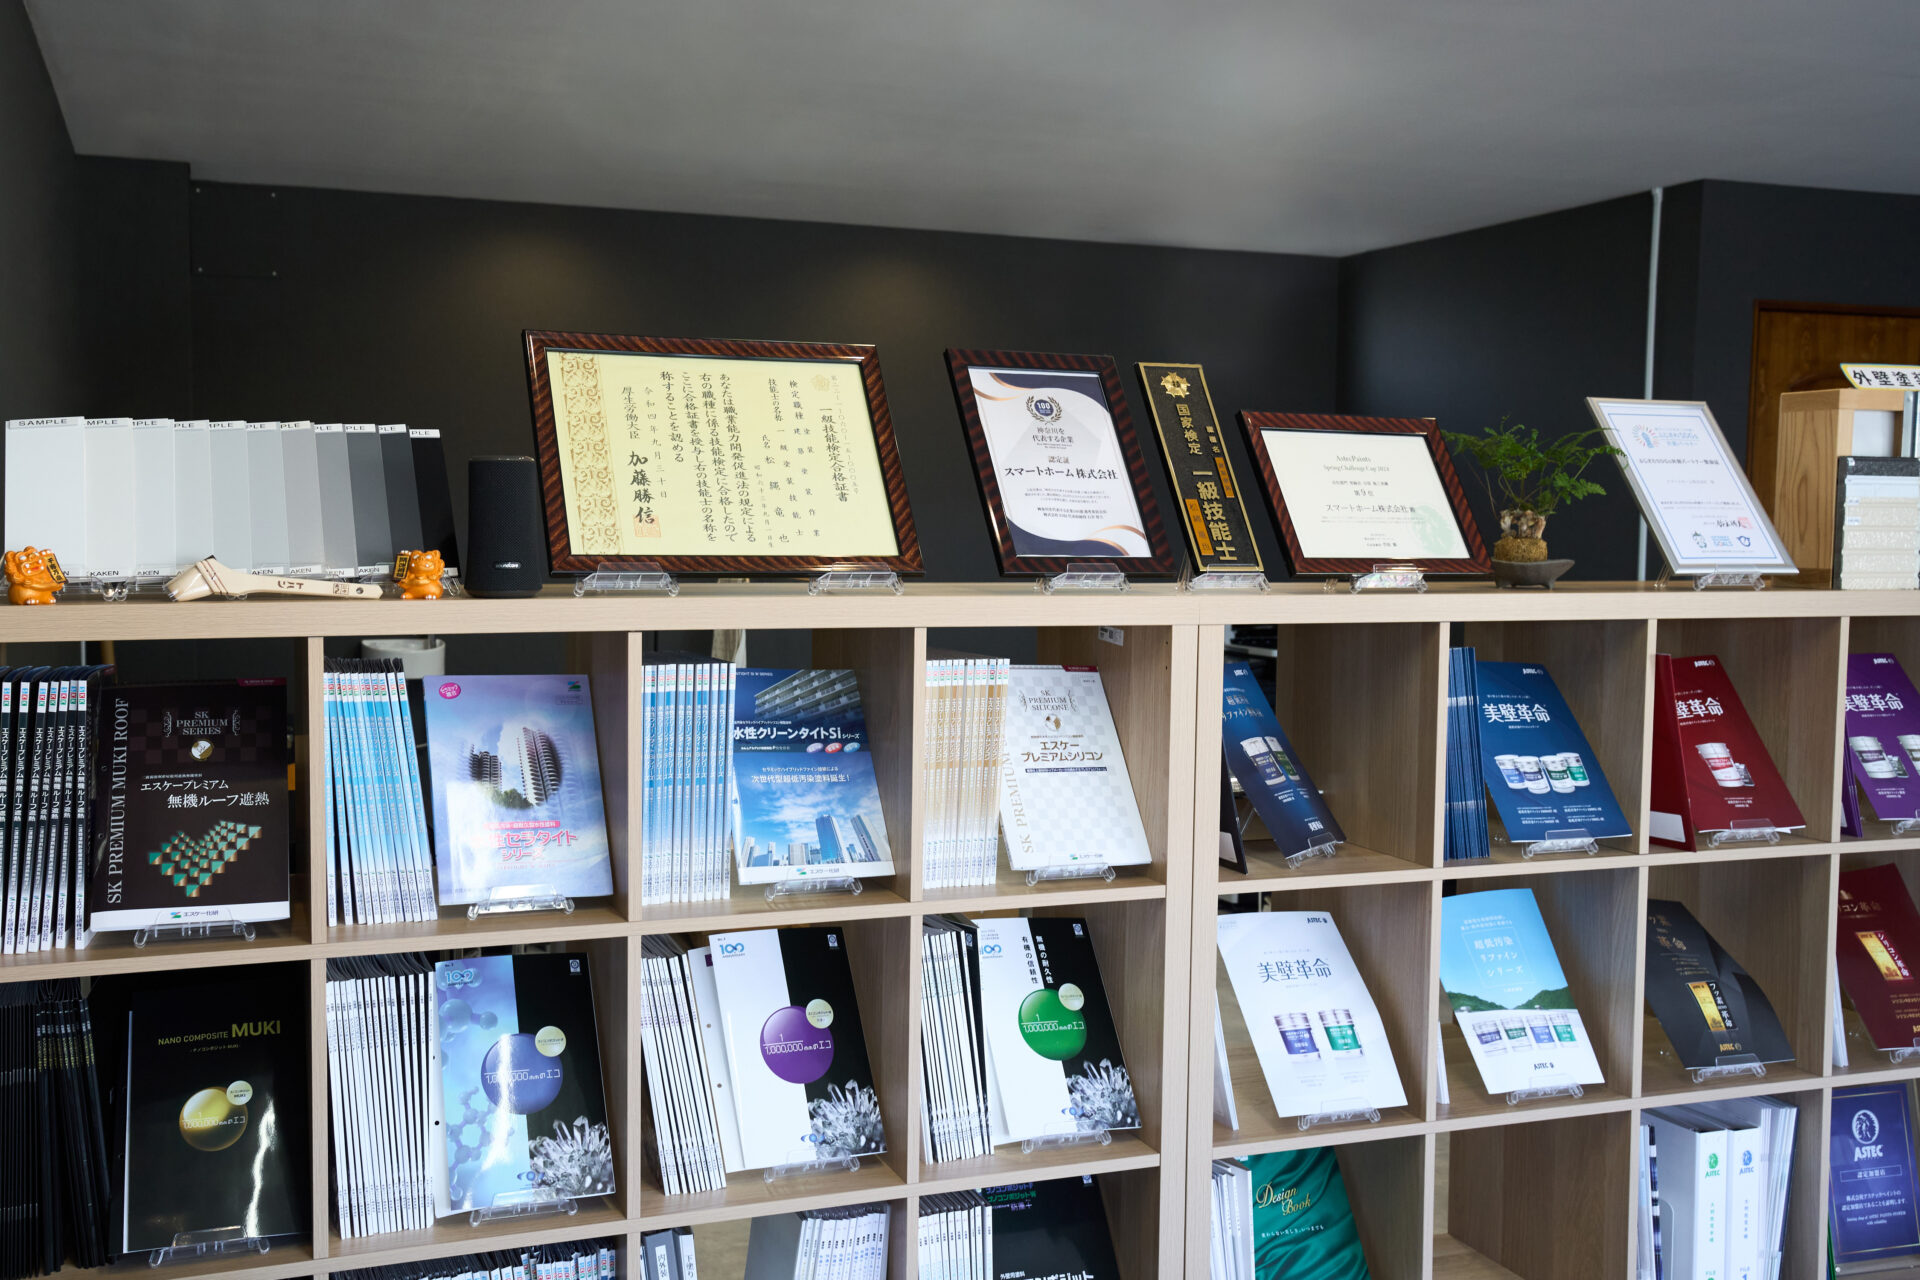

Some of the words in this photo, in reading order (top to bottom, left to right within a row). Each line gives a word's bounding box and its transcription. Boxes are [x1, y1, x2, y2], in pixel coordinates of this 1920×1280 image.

[18, 418, 68, 427] SAMPLE
[621, 386, 641, 440] 厚生労働大臣
[660, 370, 685, 464] 称することを認める
[280, 422, 301, 430] PLE
[1175, 403, 1204, 456] 国家検定
[681, 371, 718, 543] ここに合格証書を授与し右の技能士の名称を
[699, 372, 737, 543] 右の職種に係る技能検定に合格したので
[719, 373, 757, 543] あなたは職業能力開発促進法の規定による
[1004, 466, 1120, 480] スマートホーム株式会社
[627, 450, 656, 525] 加藤勝信
[1192, 470, 1238, 562] 一級技能士
[113, 698, 129, 742] ROOF
[194, 711, 209, 719] SK
[1482, 703, 1551, 723] 美壁革命
[1676, 696, 1724, 720] 壁革命
[176, 718, 228, 728] PREMIUM
[182, 727, 221, 736] SERIES
[733, 726, 842, 740] 水性クリーンタイトSi
[1020, 751, 1104, 763] プレミアムシリコン
[1040, 741, 1080, 751] エスケー
[111, 745, 128, 791] MUKI
[140, 779, 229, 792] エスケープレミアム
[167, 791, 271, 809] 無機ルーフ遮熱
[108, 794, 126, 876] PREMIUM
[472, 830, 578, 848] 性セラタイト
[501, 848, 545, 862] シリーズ
[107, 880, 123, 904] SK
[1257, 958, 1332, 984] 美壁革命
[158, 1036, 182, 1046] NANO
[183, 1031, 229, 1043] COMPOSITE
[231, 1020, 281, 1038] MUKI
[1854, 1145, 1883, 1162] ASTEC
[1256, 1182, 1297, 1209] Design
[1282, 1192, 1311, 1216] Book
